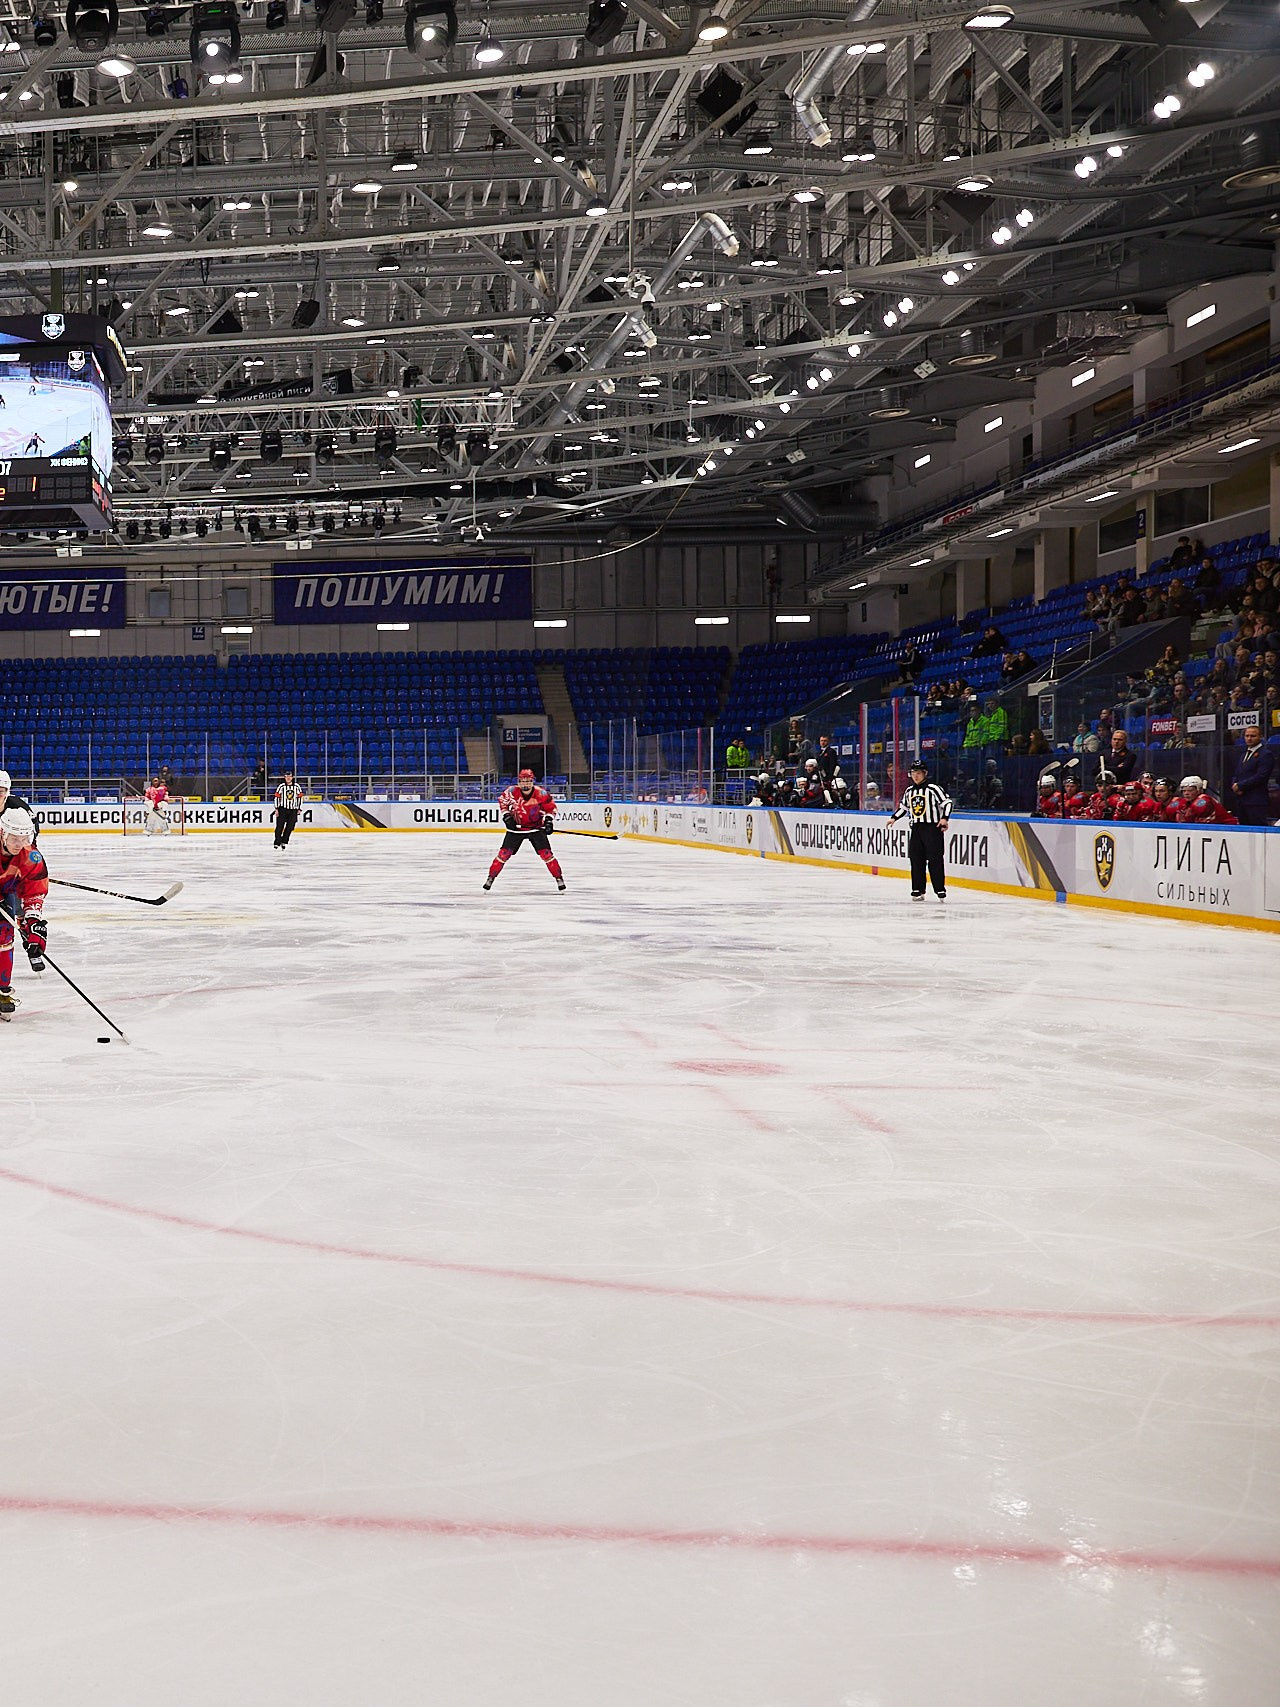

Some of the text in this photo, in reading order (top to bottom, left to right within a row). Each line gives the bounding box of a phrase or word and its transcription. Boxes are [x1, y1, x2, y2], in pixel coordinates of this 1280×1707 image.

[32, 476, 37, 492] 1
[1138, 513, 1144, 527] 2
[294, 573, 505, 608] ПОШУМИМ!
[1152, 720, 1178, 732] FONBET
[413, 809, 499, 823] OHLIGA.RU
[795, 822, 988, 867] ОФИЦЕРСКАЯ ХОККЕ ЛИГА
[1153, 835, 1232, 875] ЛИГА
[1157, 881, 1231, 906] СИЛЬНЫХ
